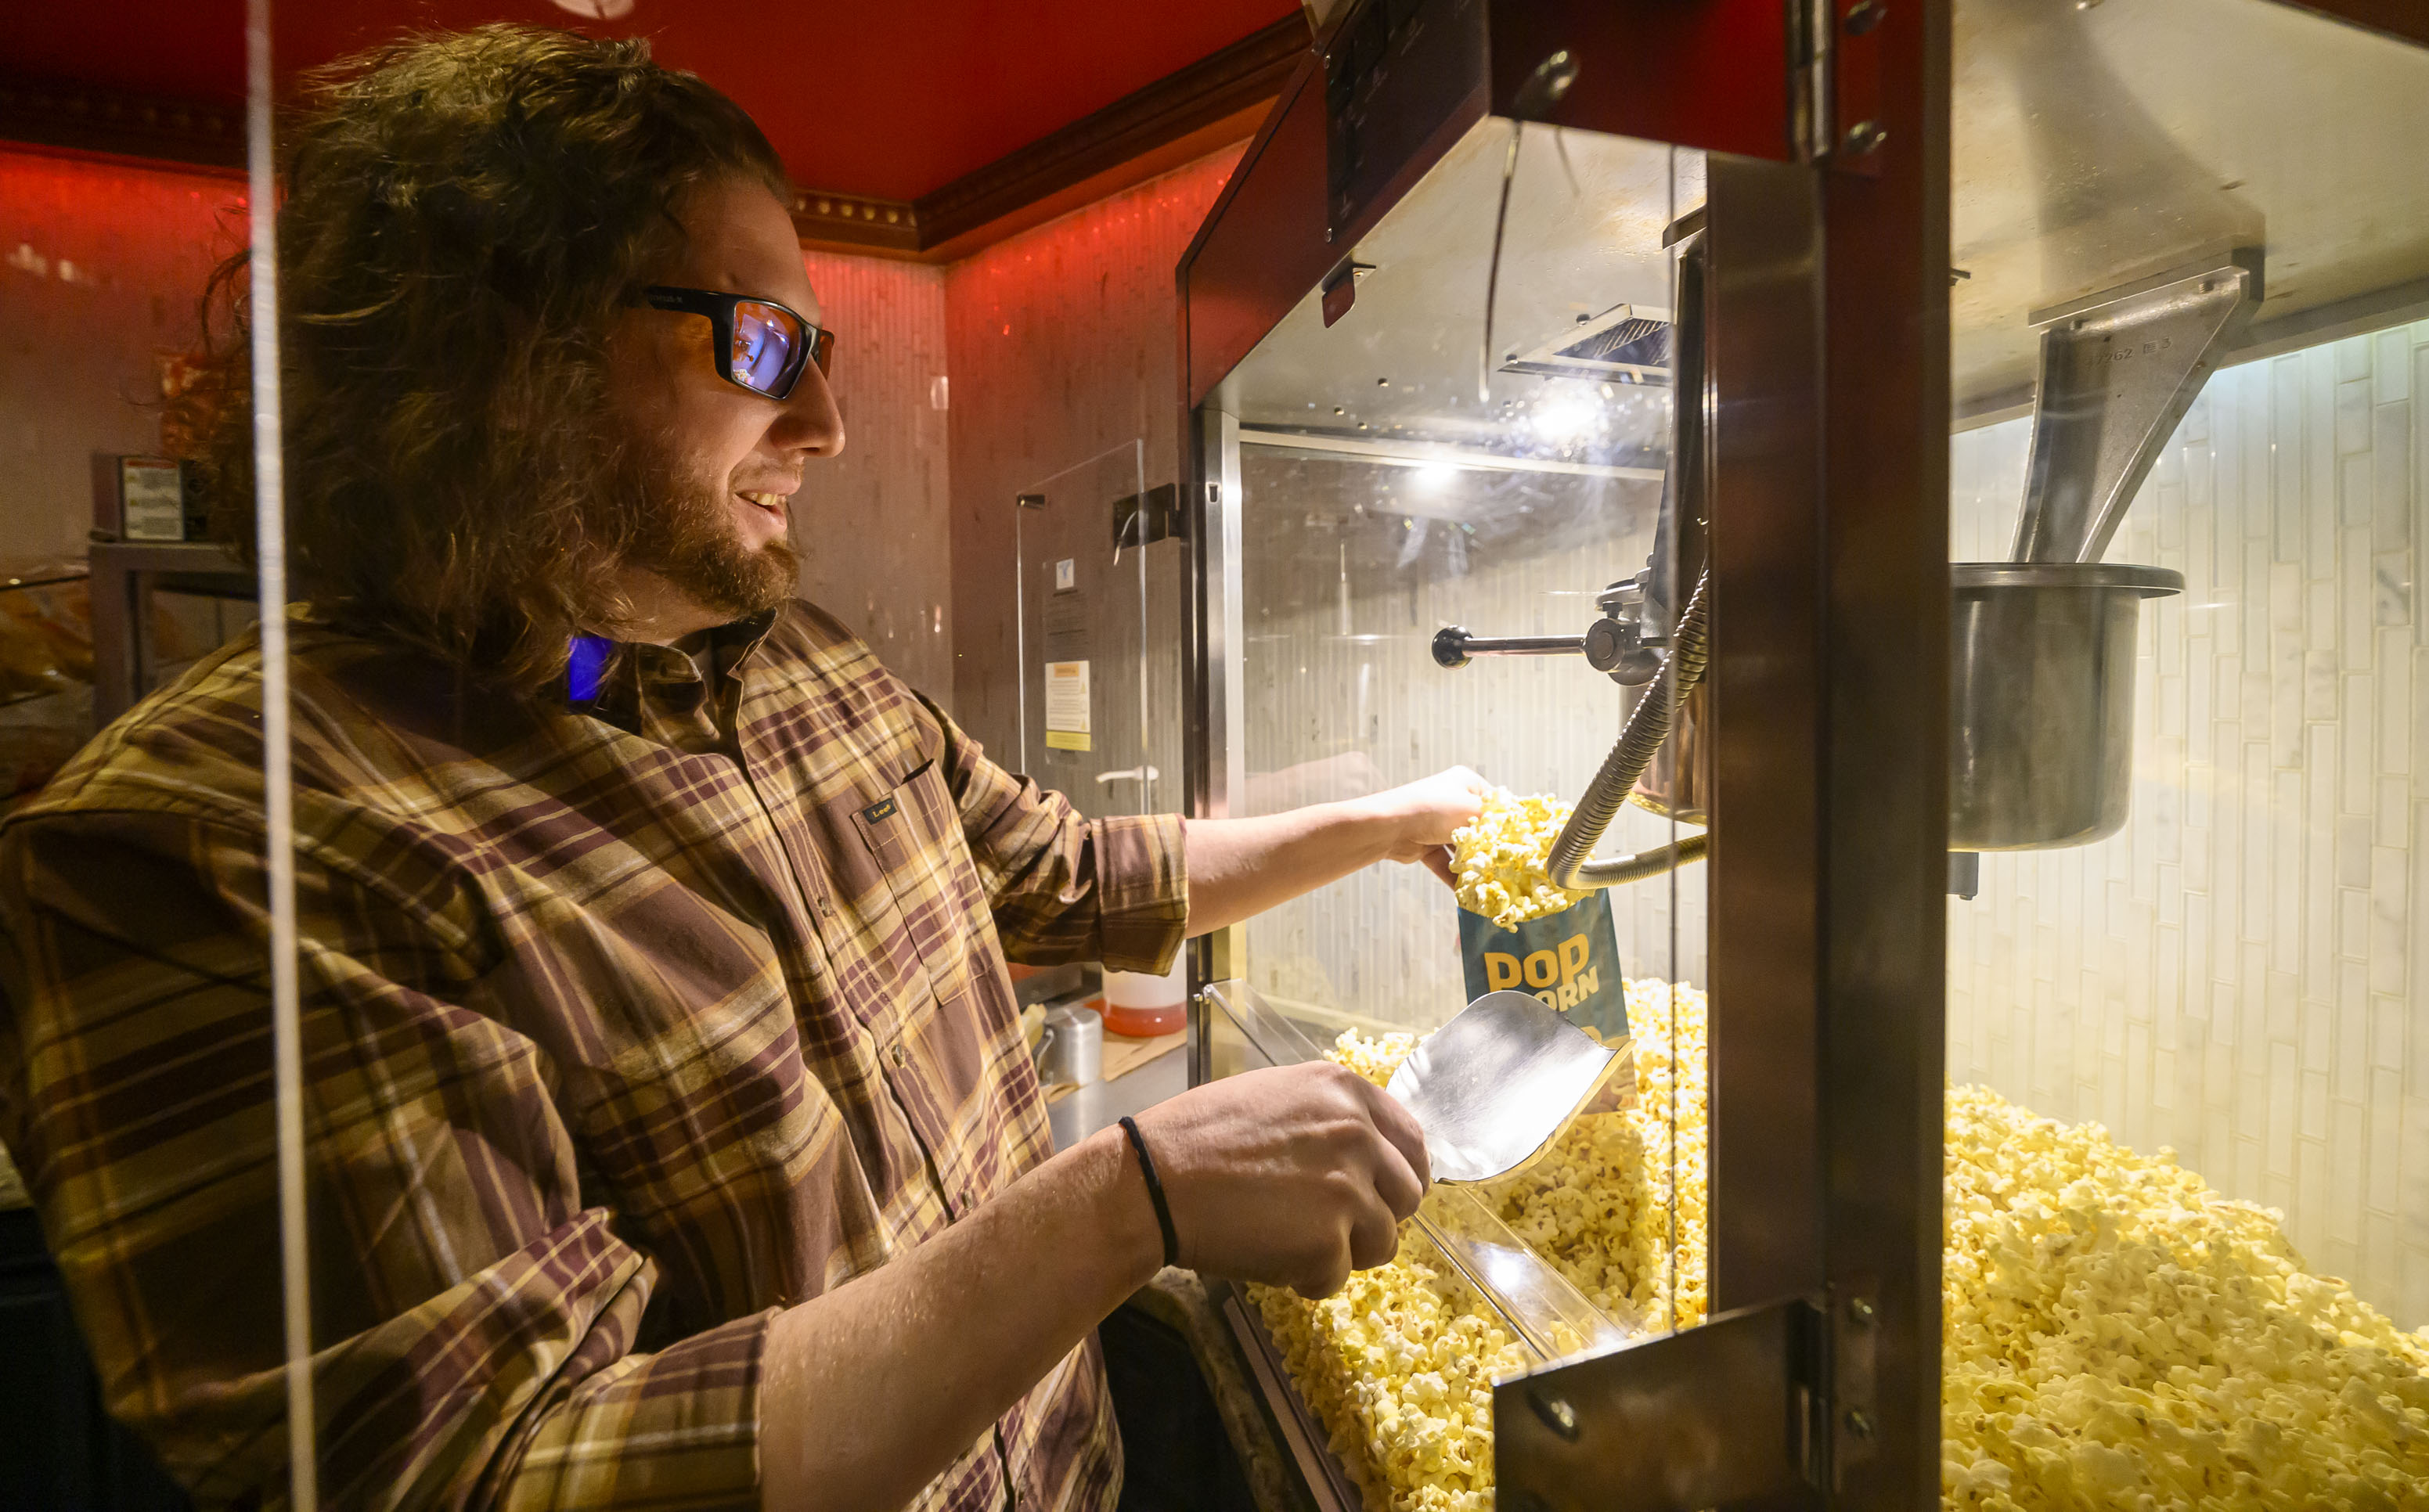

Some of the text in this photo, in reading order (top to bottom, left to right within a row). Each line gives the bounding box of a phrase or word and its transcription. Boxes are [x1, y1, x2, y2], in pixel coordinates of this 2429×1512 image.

[872, 804, 891, 818] Lee
[1484, 934, 1589, 992] POP
[1533, 965, 1599, 1012] ORN
